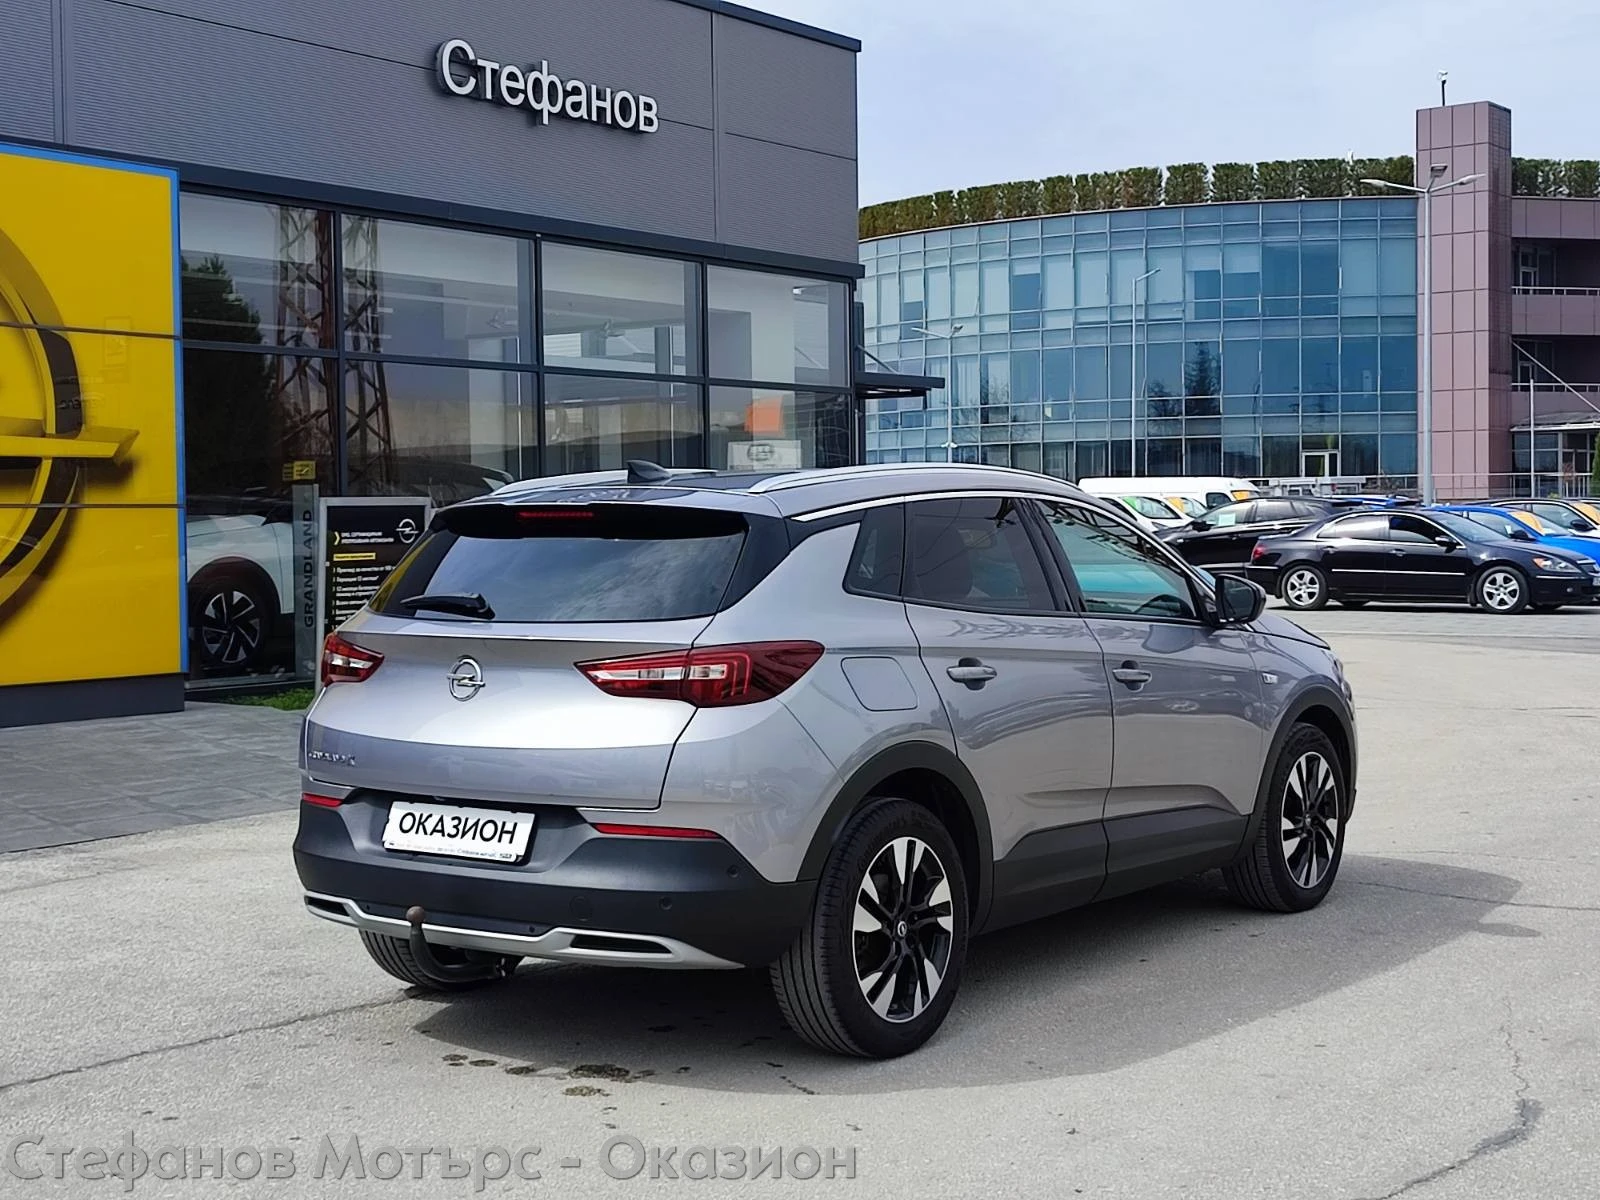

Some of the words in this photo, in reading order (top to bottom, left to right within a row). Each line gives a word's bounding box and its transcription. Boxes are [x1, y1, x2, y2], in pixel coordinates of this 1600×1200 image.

[440, 38, 659, 133] Стефанов
[303, 510, 314, 628] GRANDLAND
[398, 811, 518, 845] ОКАЗИОН
